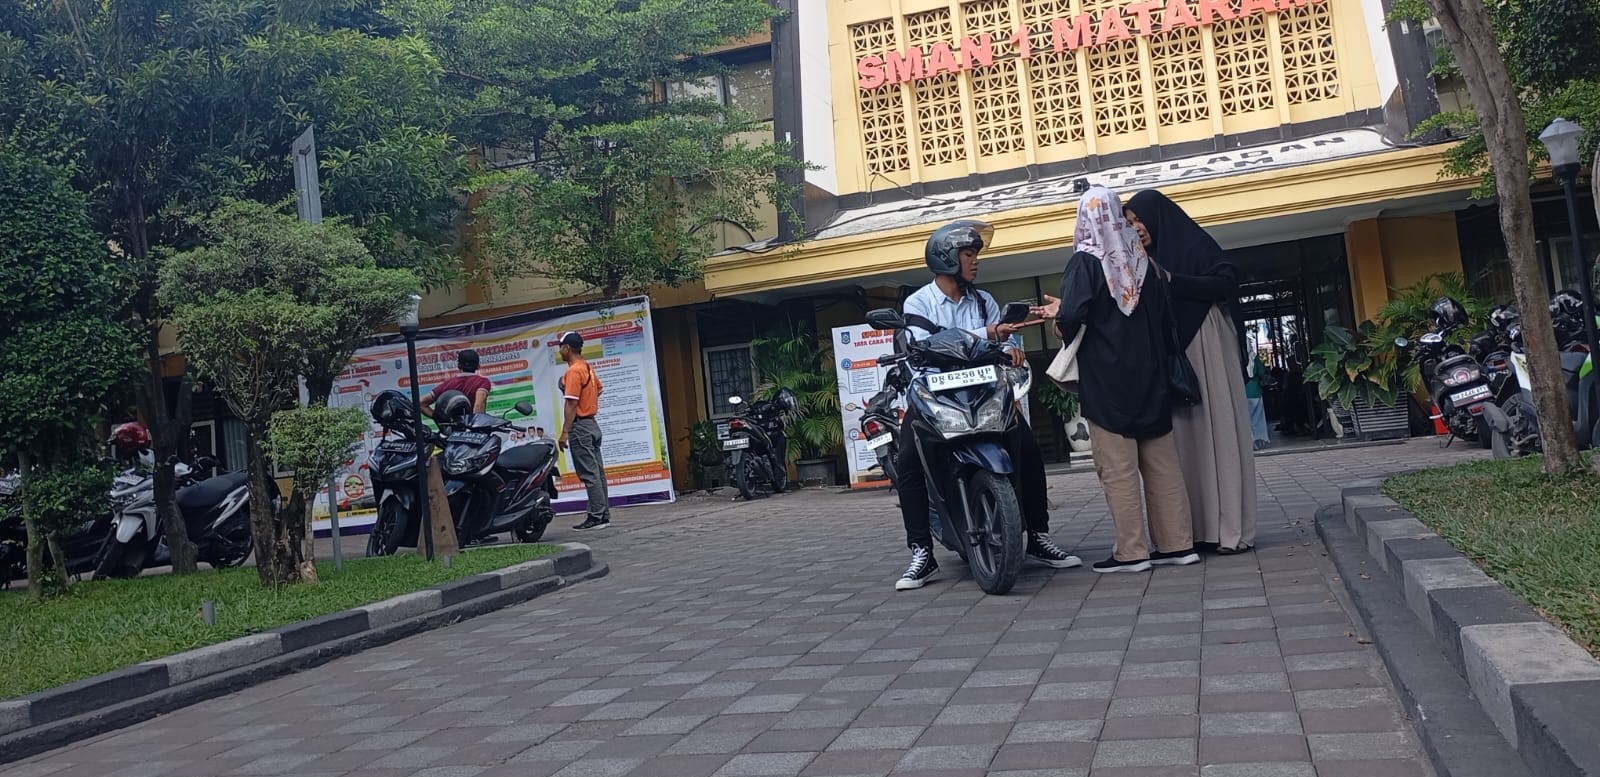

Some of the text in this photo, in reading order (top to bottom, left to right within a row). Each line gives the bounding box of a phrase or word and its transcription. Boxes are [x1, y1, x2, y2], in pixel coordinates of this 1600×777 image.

[857, 0, 1326, 89] SMAN 1 MATAR
[1102, 136, 1346, 179] TELADAN
